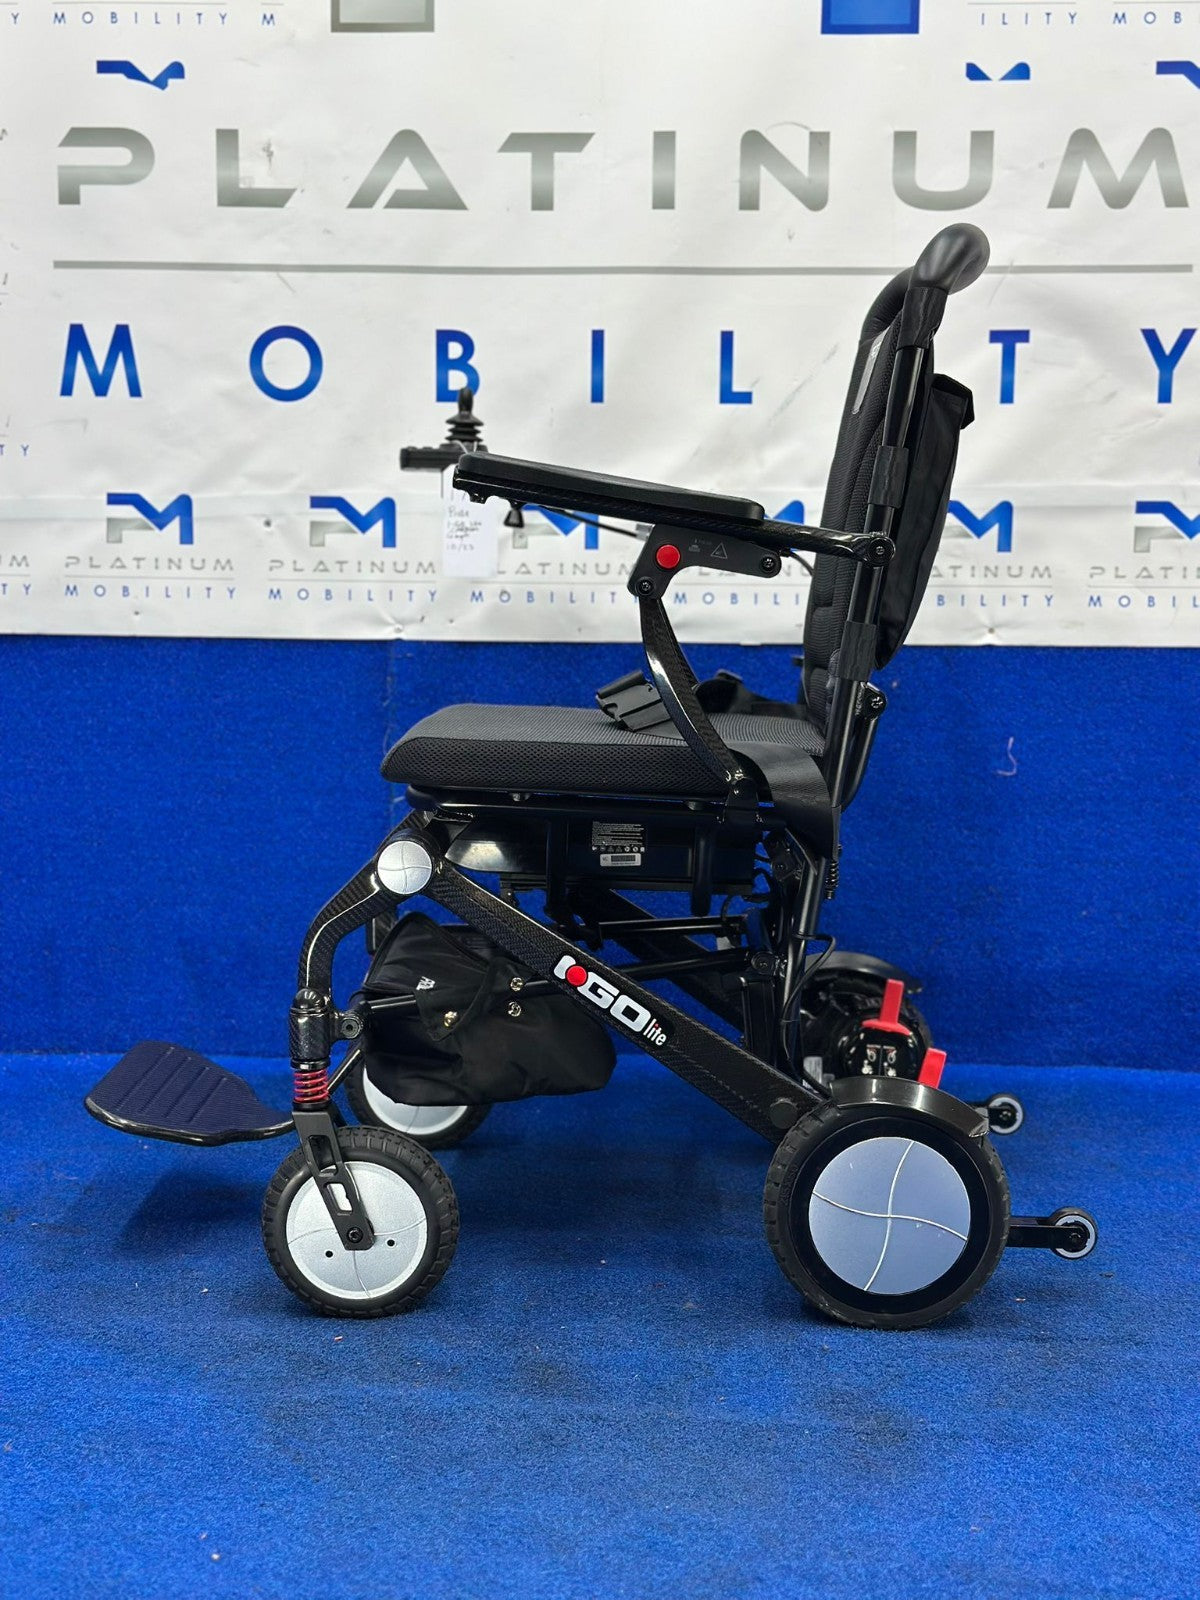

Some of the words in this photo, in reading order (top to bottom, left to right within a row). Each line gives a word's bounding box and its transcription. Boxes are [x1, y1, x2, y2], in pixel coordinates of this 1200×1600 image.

[53, 11, 228, 26] MOBILITY
[57, 126, 1189, 212] PLATINUM
[60, 323, 1197, 403] MOBILTY
[64, 556, 234, 572] PLATINUM
[269, 559, 436, 574] PLATINUM
[1089, 566, 1200, 579] PLATI
[64, 584, 236, 599] MOBILITY
[268, 587, 437, 602] MOBILITY
[642, 1018, 667, 1046] lite
